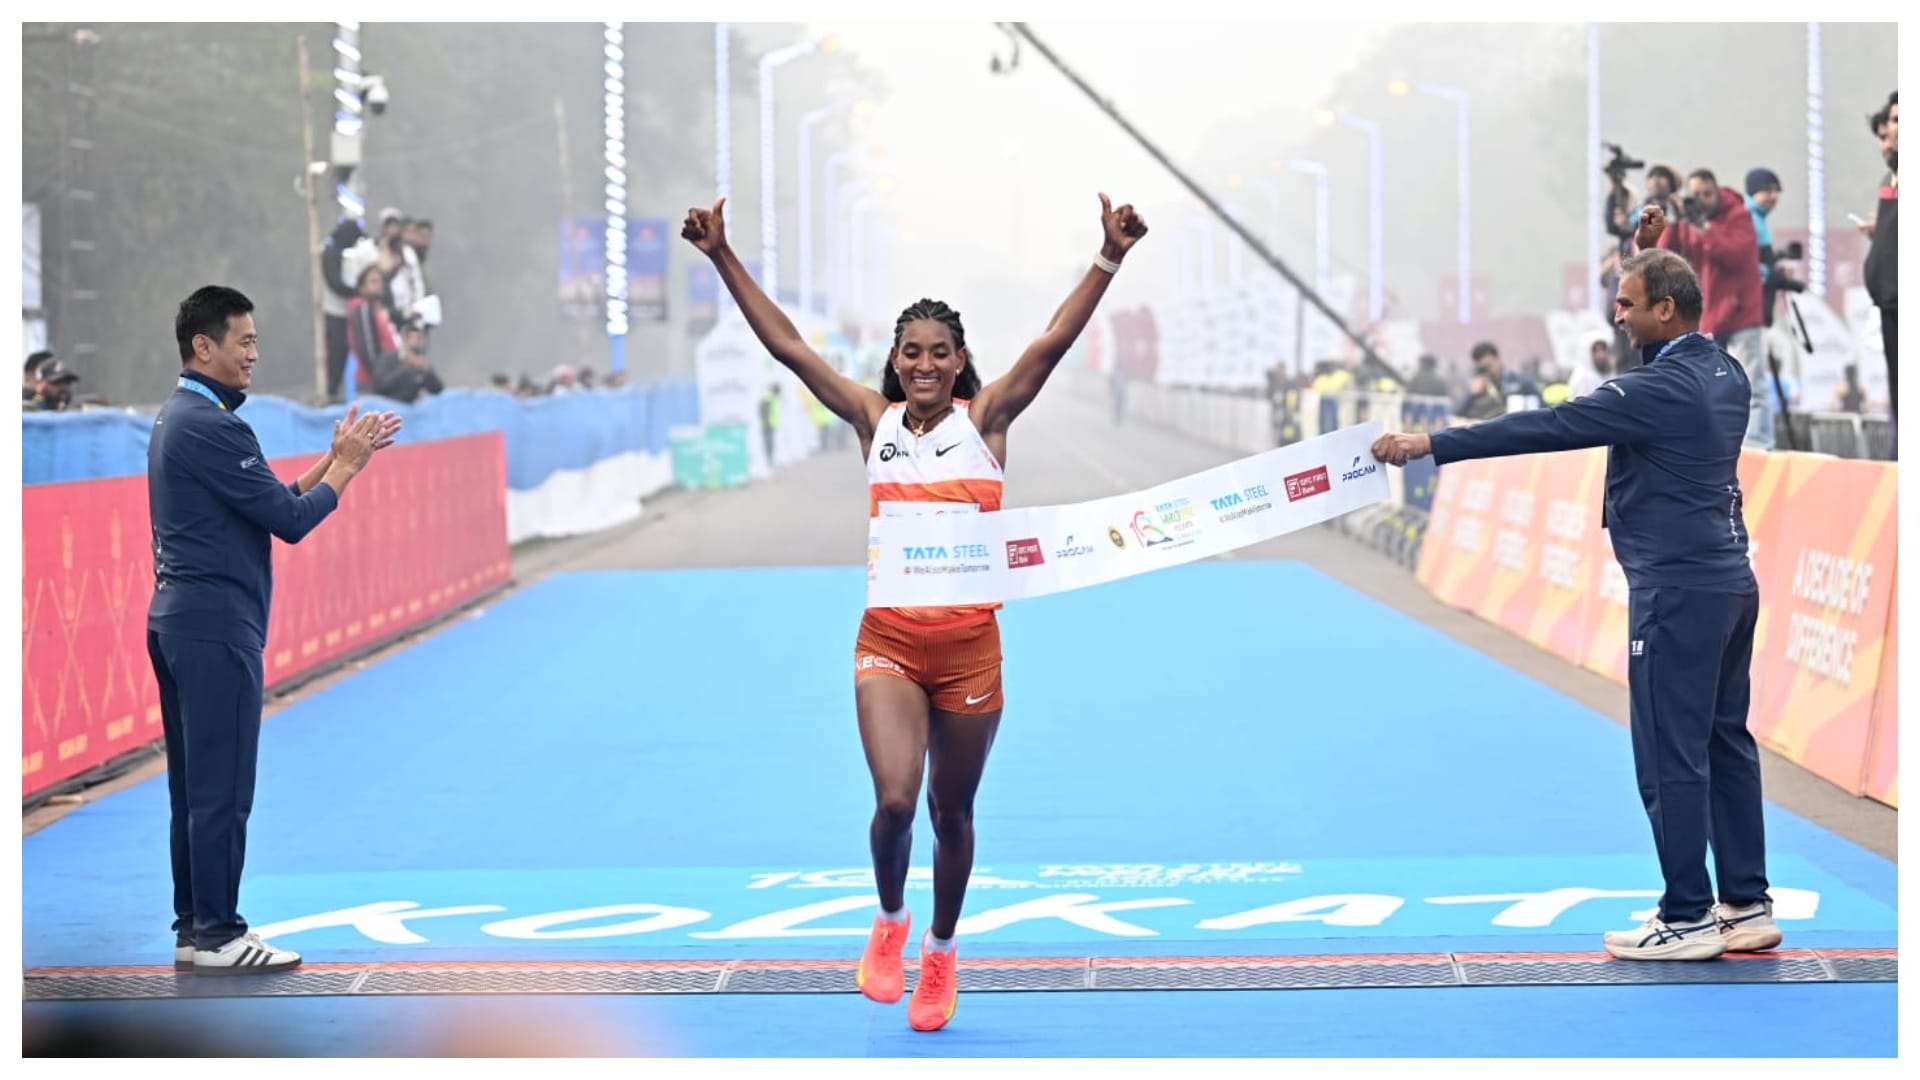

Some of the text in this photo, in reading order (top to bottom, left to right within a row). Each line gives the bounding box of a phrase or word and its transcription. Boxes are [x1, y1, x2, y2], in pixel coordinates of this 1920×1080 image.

[1342, 465, 1377, 483] PROCAM
[1210, 484, 1269, 511] TATA STEEL
[903, 544, 990, 560] TATA STEEL
[1803, 548, 1856, 613] DECADE
[1851, 559, 1873, 616] OF
[1786, 611, 1857, 688] DIFFERENCE
